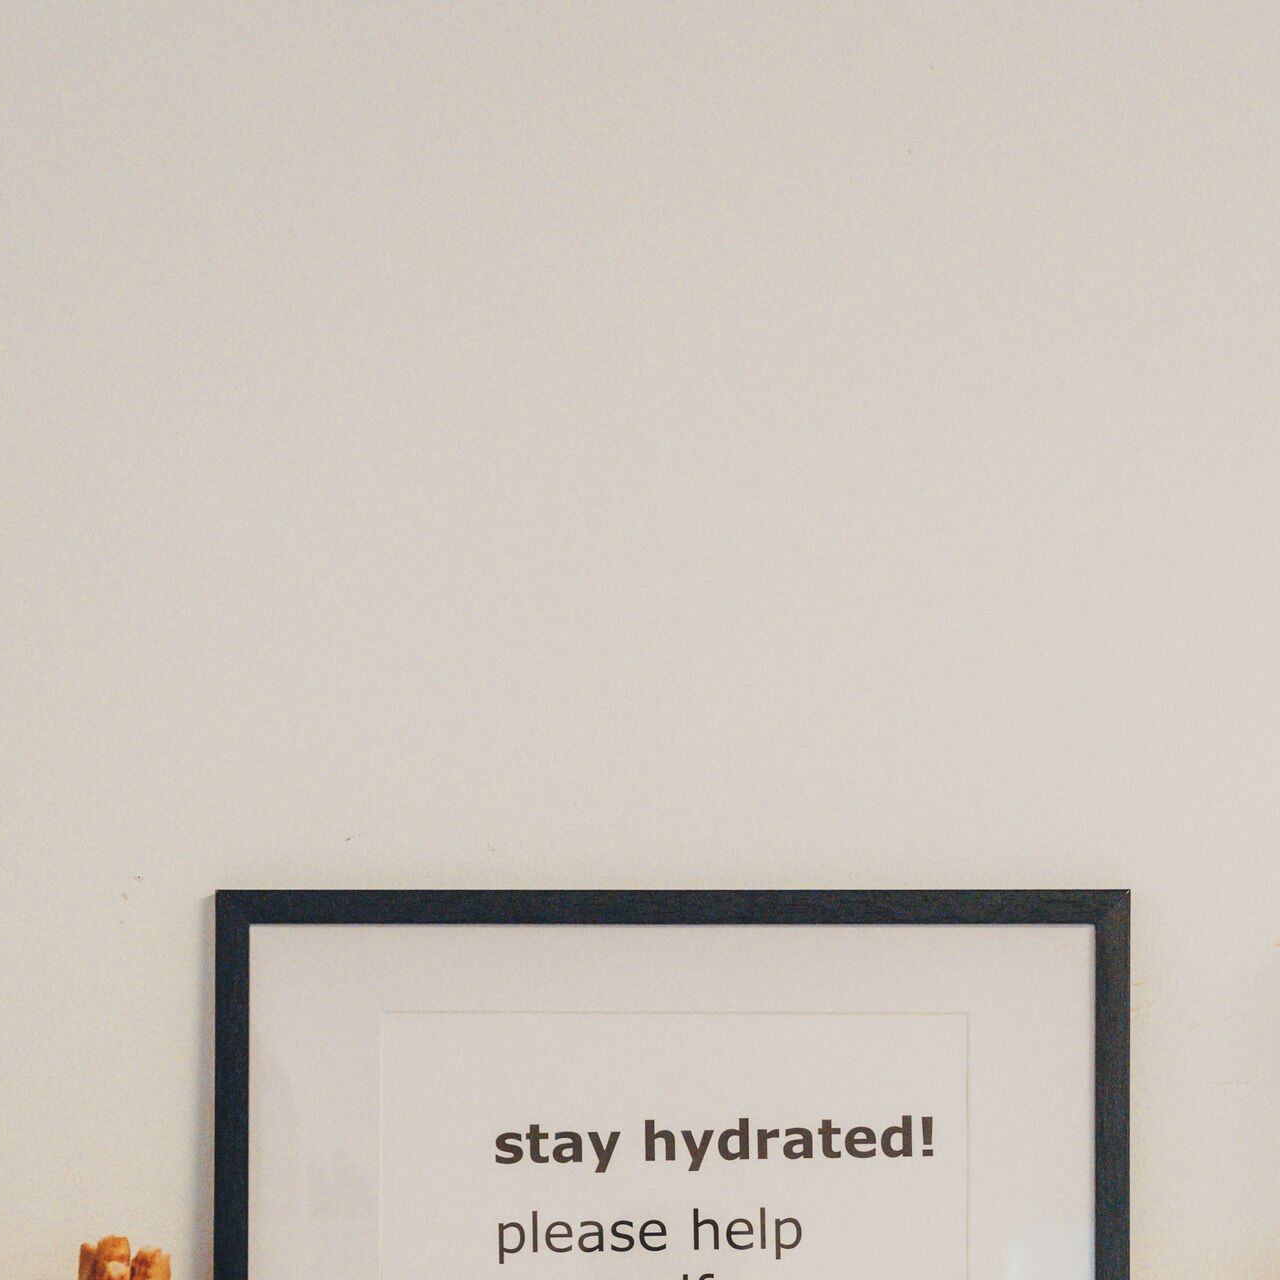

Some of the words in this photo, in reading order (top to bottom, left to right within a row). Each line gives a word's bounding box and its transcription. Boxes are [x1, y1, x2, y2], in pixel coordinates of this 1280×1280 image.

[495, 1123, 621, 1173] stay
[644, 1114, 936, 1172] hydrated!
[497, 1210, 668, 1265] please
[692, 1207, 803, 1260] help
